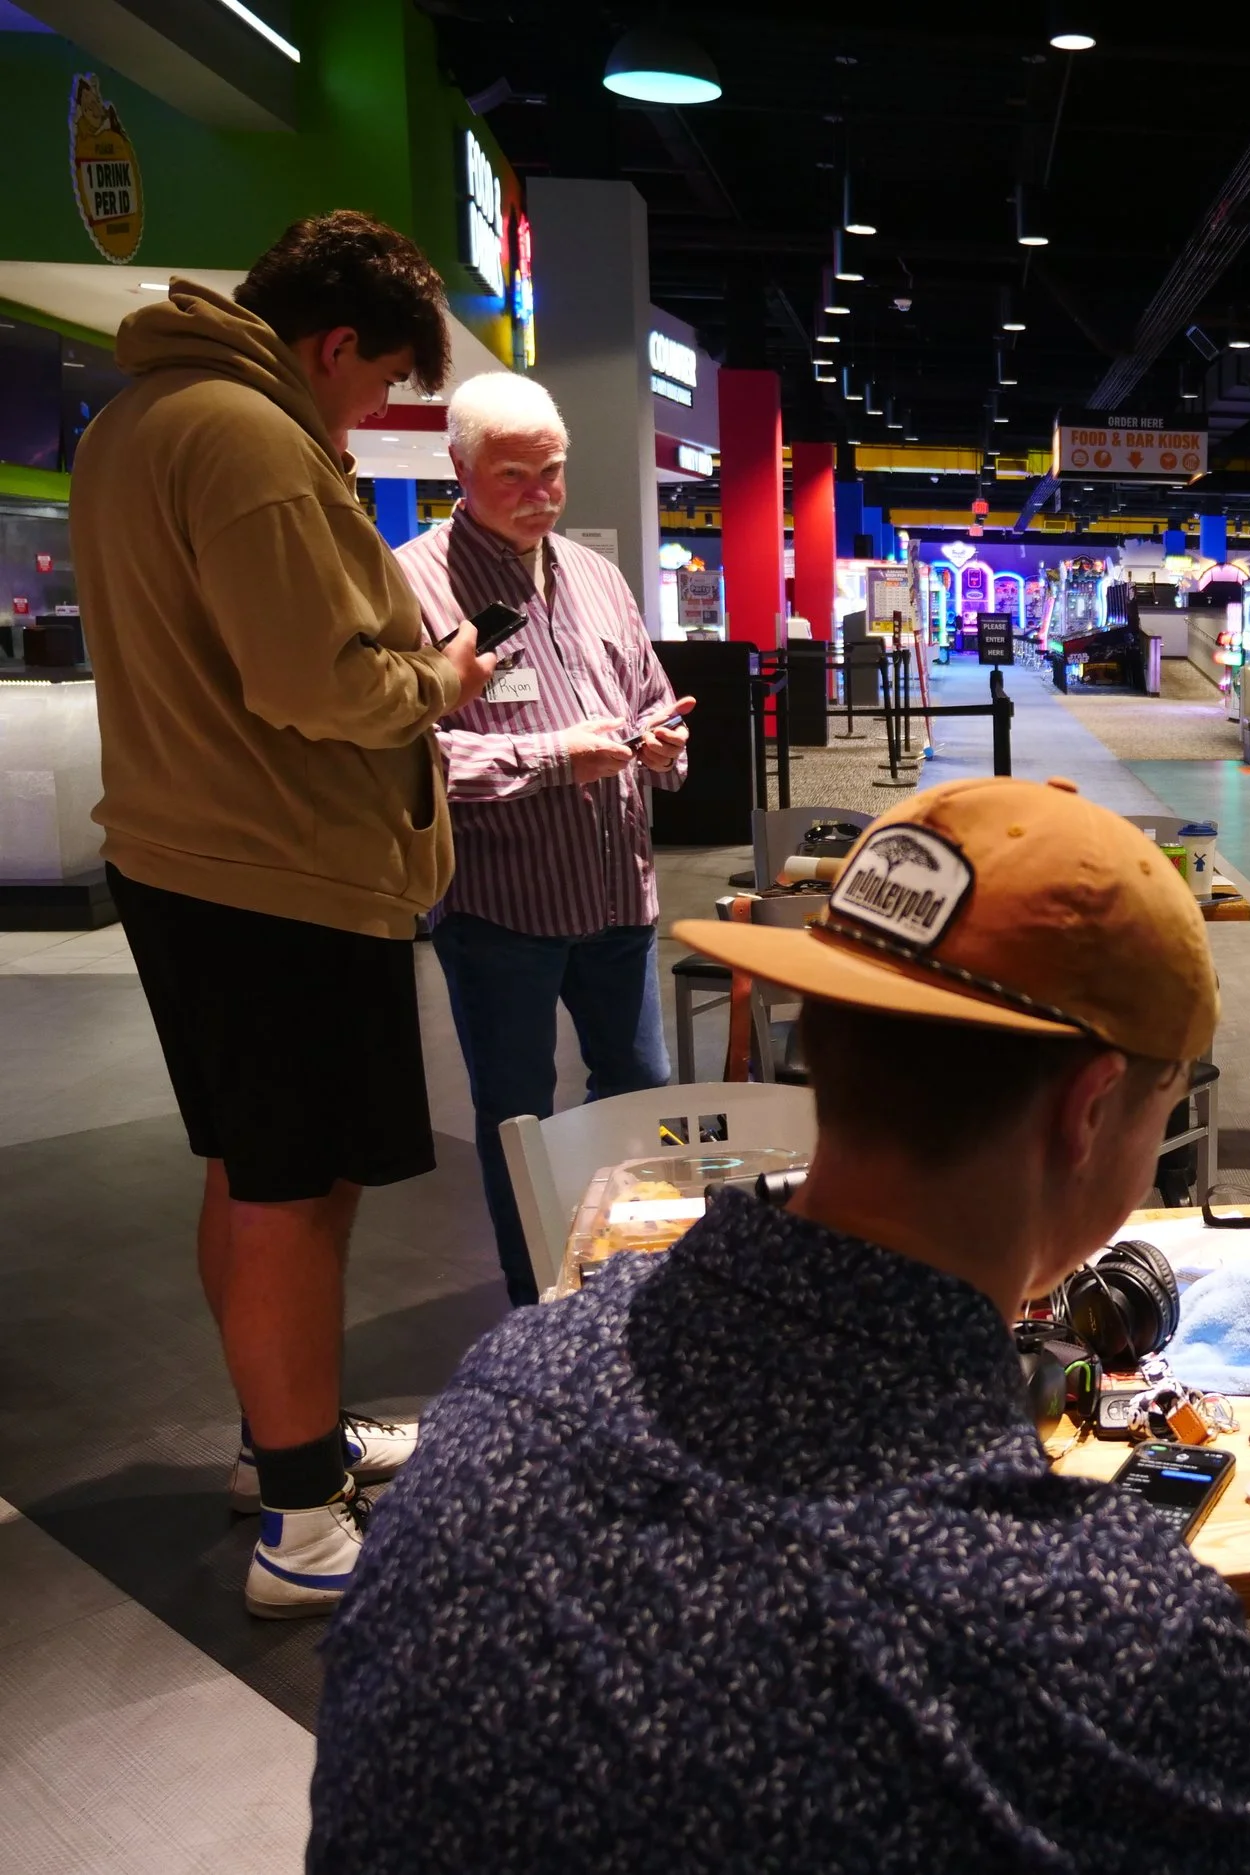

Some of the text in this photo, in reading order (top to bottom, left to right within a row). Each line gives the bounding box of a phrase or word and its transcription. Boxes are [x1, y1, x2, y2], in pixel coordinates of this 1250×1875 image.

[87, 162, 131, 189] 1 DRINK
[467, 130, 494, 224] FOOD
[94, 190, 130, 216] PER ID
[1108, 416, 1164, 429] ORDER HERE
[1071, 430, 1200, 450] FOOD & BAR KIOSK
[983, 623, 1007, 631] PLEASE
